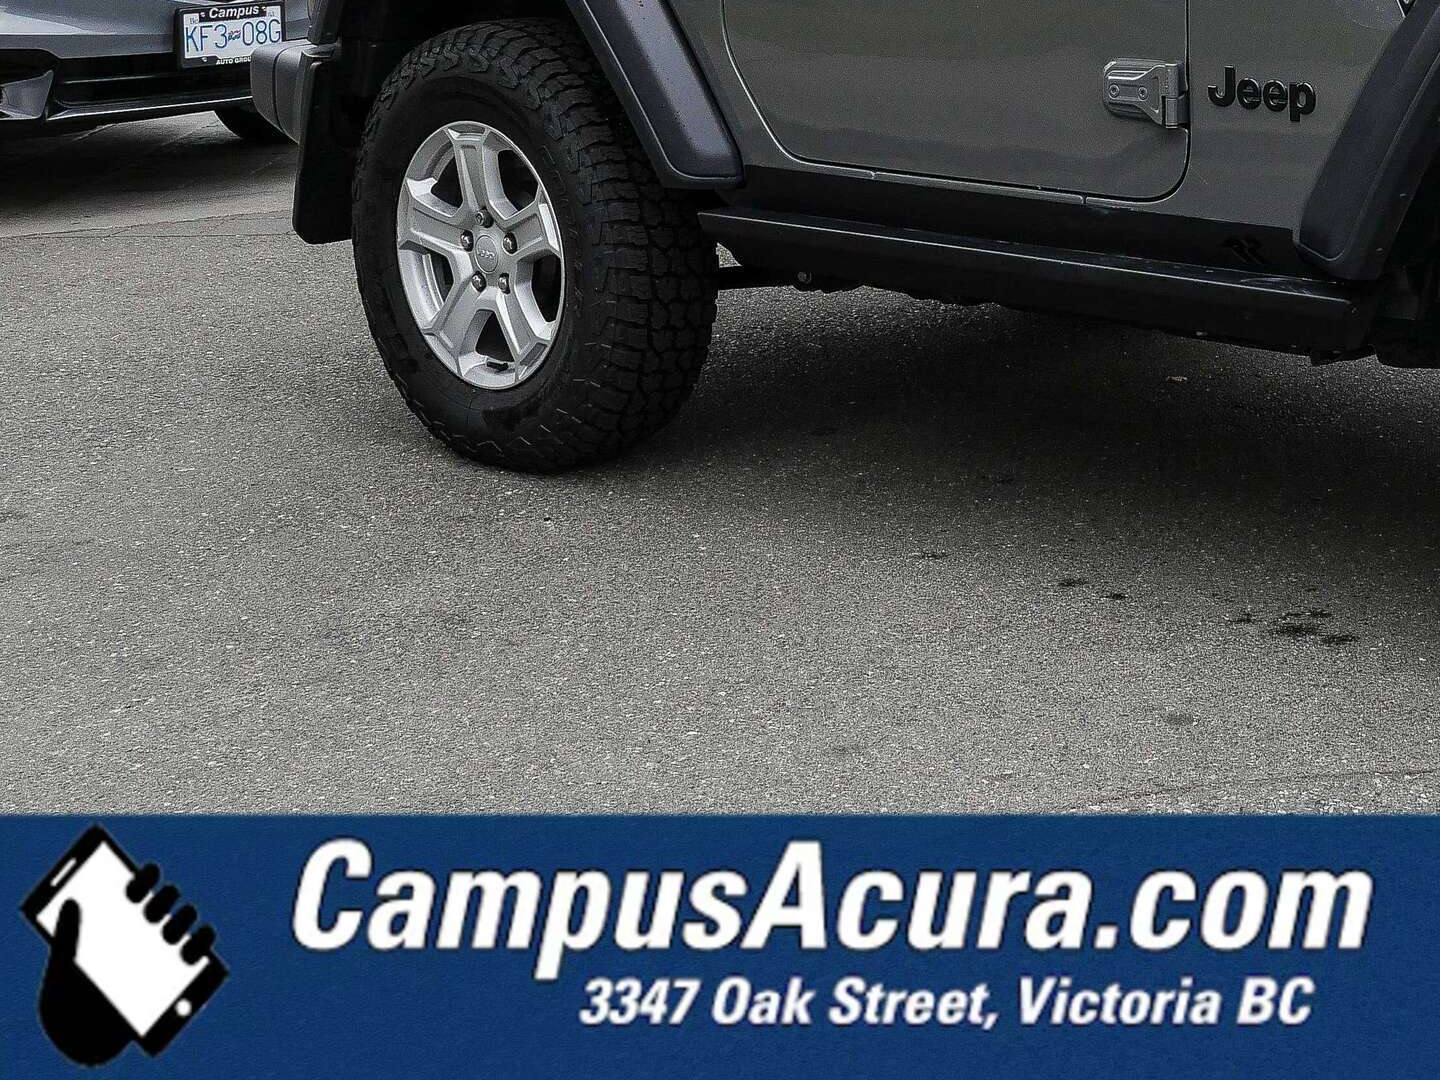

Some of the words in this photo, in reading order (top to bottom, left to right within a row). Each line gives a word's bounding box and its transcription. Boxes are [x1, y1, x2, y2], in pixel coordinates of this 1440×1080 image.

[209, 5, 260, 19] Campus
[185, 24, 228, 53] KF3
[216, 58, 234, 66] AUTO
[234, 56, 252, 64] GROU
[1207, 65, 1316, 122] Jeep
